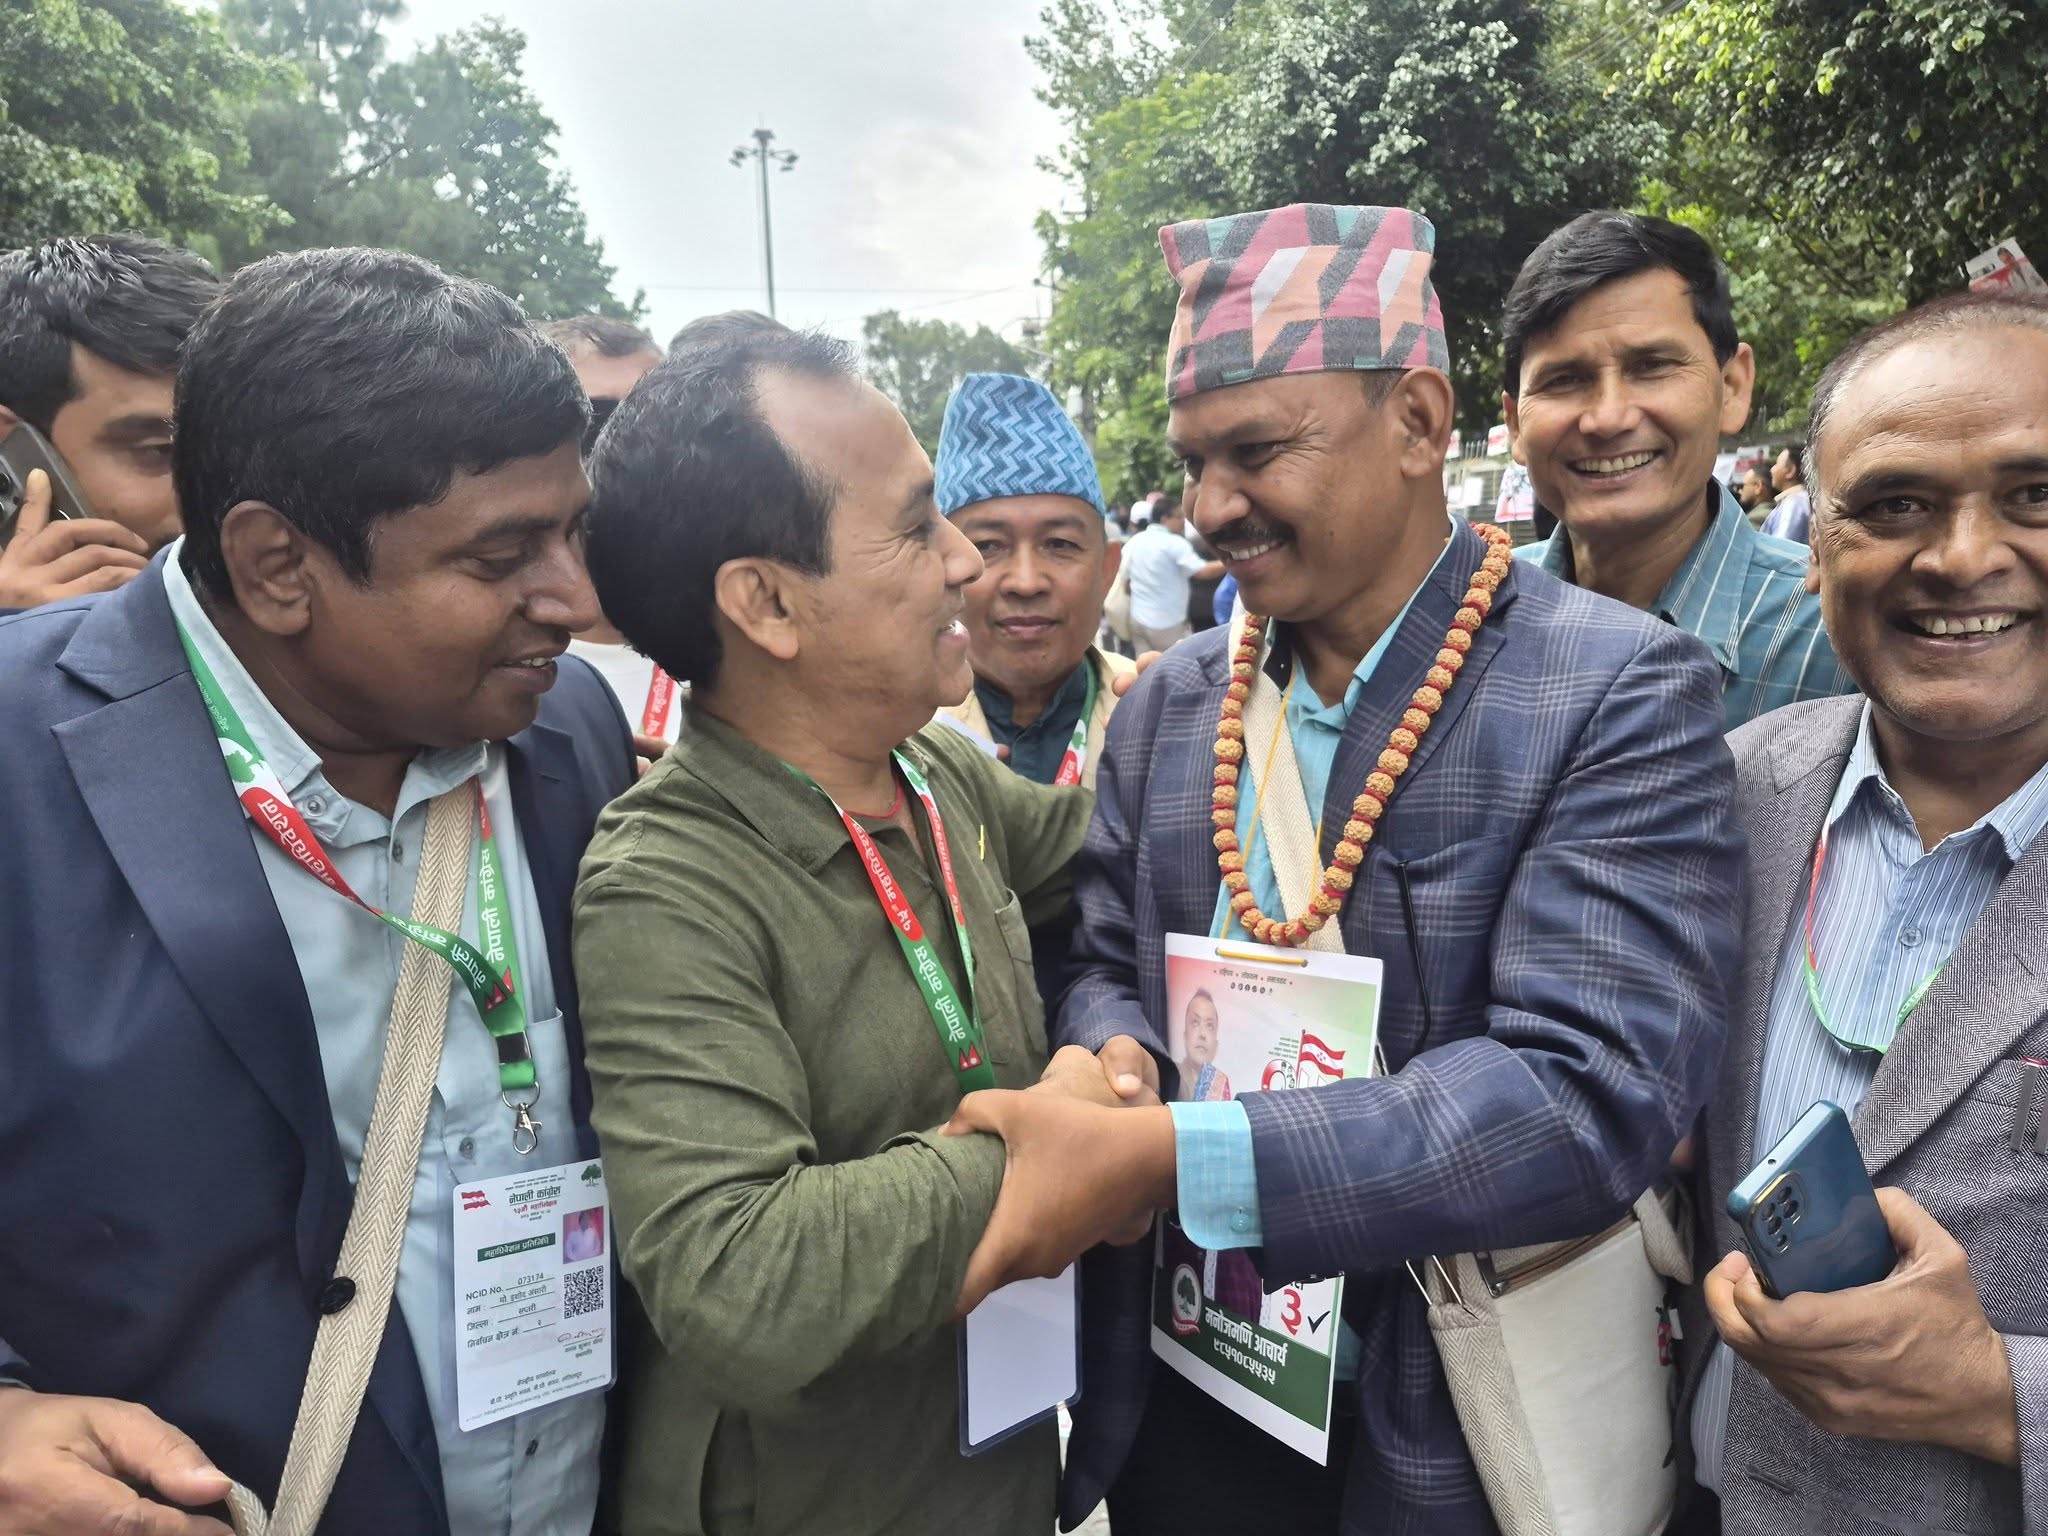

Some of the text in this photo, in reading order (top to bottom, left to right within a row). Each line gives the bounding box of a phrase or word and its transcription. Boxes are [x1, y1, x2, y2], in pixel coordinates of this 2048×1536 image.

[258, 798, 337, 886] महाधिवेशन
[479, 848, 504, 963] नेपाली कांग्रेस
[391, 916, 487, 990] नेपाली कांग्रेस
[912, 946, 943, 995] कांग्रेस
[937, 996, 967, 1043] नेपाली
[509, 1185, 561, 1204] नेपाली कांग्रेस
[466, 1272, 544, 1301] NCID No. 073174
[466, 1319, 489, 1331] जिल्ला
[1280, 1288, 1302, 1336] ३
[467, 1334, 493, 1349] निर्वाचन
[1205, 1306, 1288, 1367] मनोजमणि आचार्य
